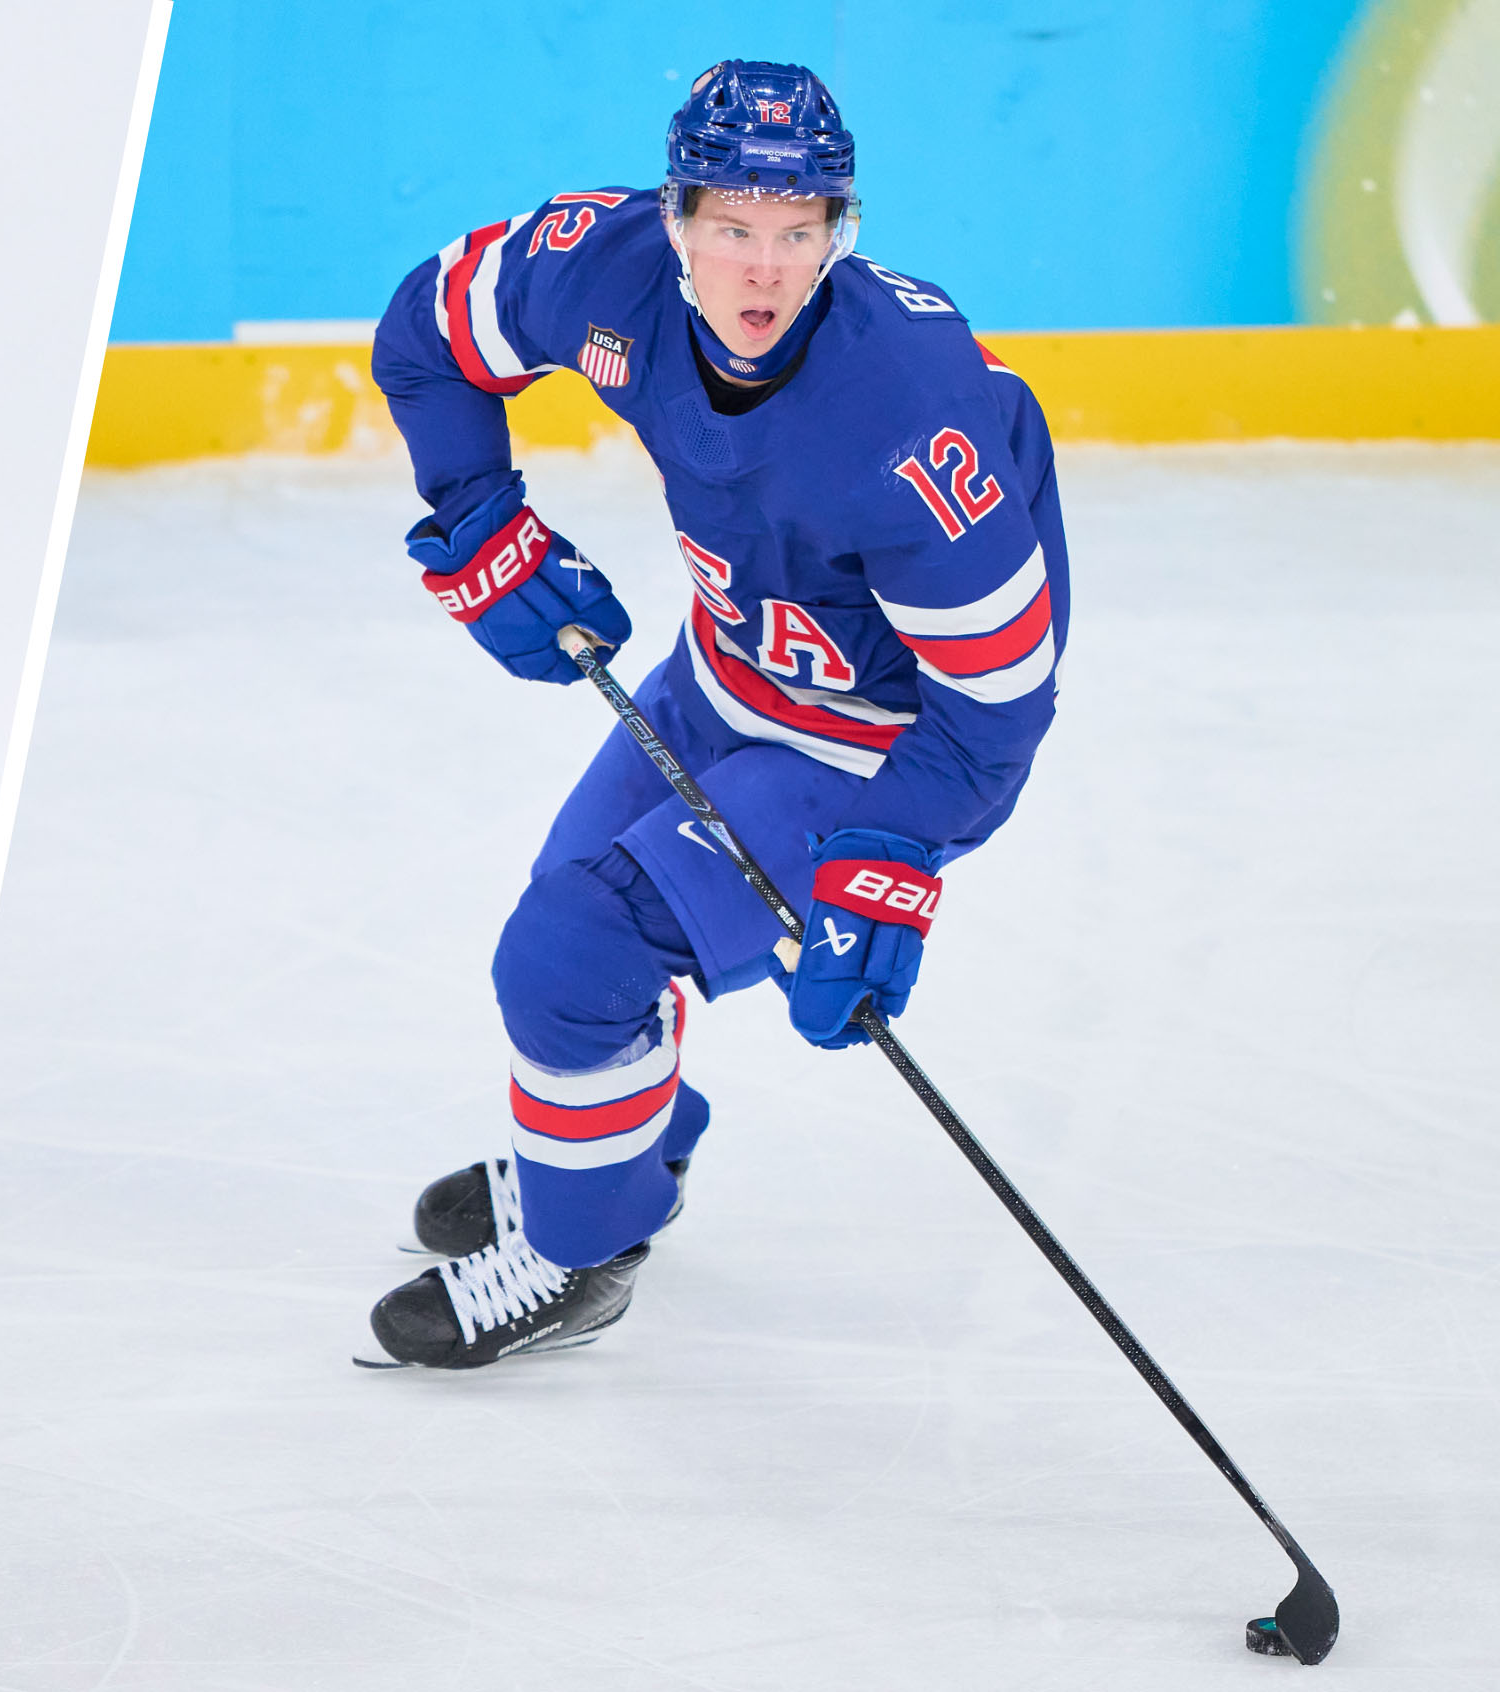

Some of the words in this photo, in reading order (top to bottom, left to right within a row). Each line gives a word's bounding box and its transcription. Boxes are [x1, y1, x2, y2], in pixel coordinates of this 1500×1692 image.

[757, 100, 791, 125] 12
[745, 148, 774, 156] MILANO
[774, 151, 804, 159] CORTINA
[526, 191, 630, 259] 12
[852, 252, 956, 312] BO
[593, 331, 622, 353] USA
[892, 426, 1005, 542] 12
